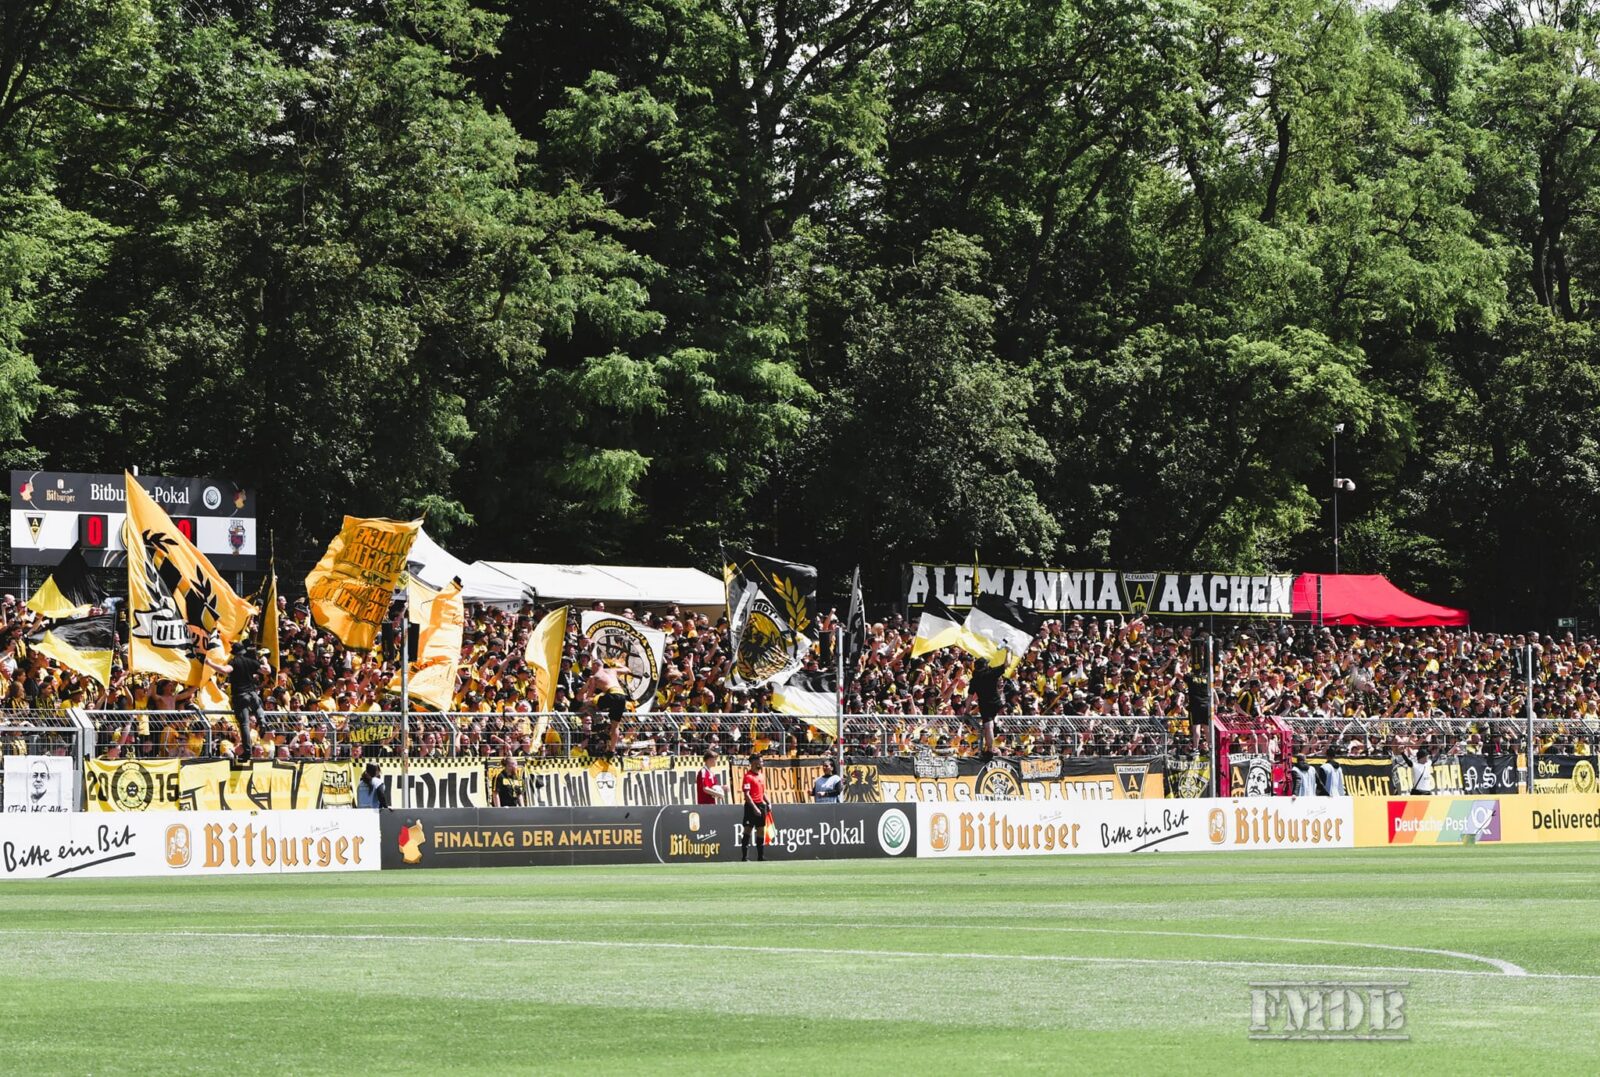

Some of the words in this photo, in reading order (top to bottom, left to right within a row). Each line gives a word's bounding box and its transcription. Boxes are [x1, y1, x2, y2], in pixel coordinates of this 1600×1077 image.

[46, 489, 76, 503] Bitburger
[90, 483, 190, 505] Bitbu-Pokal
[87, 516, 103, 547] 0
[907, 564, 1122, 611] ALEMANNIA
[1158, 573, 1294, 614] AACHEN
[958, 812, 1081, 851] Bitburger
[1101, 823, 1134, 848] Bitte
[1136, 822, 1161, 839] ein
[1163, 809, 1189, 832] Bit
[1234, 807, 1344, 845] Bitburger
[1394, 817, 1443, 833] Deutsche
[1445, 817, 1469, 832] Post
[1532, 809, 1600, 830] Delivered
[4, 841, 52, 873] Bitte
[58, 839, 95, 860] ein
[98, 824, 136, 852] Bit
[203, 822, 365, 868] Bitburger
[434, 830, 515, 849] FINALTAG
[522, 830, 554, 847] DER
[559, 828, 643, 846] AMATEURE
[669, 834, 721, 858] Bitburger
